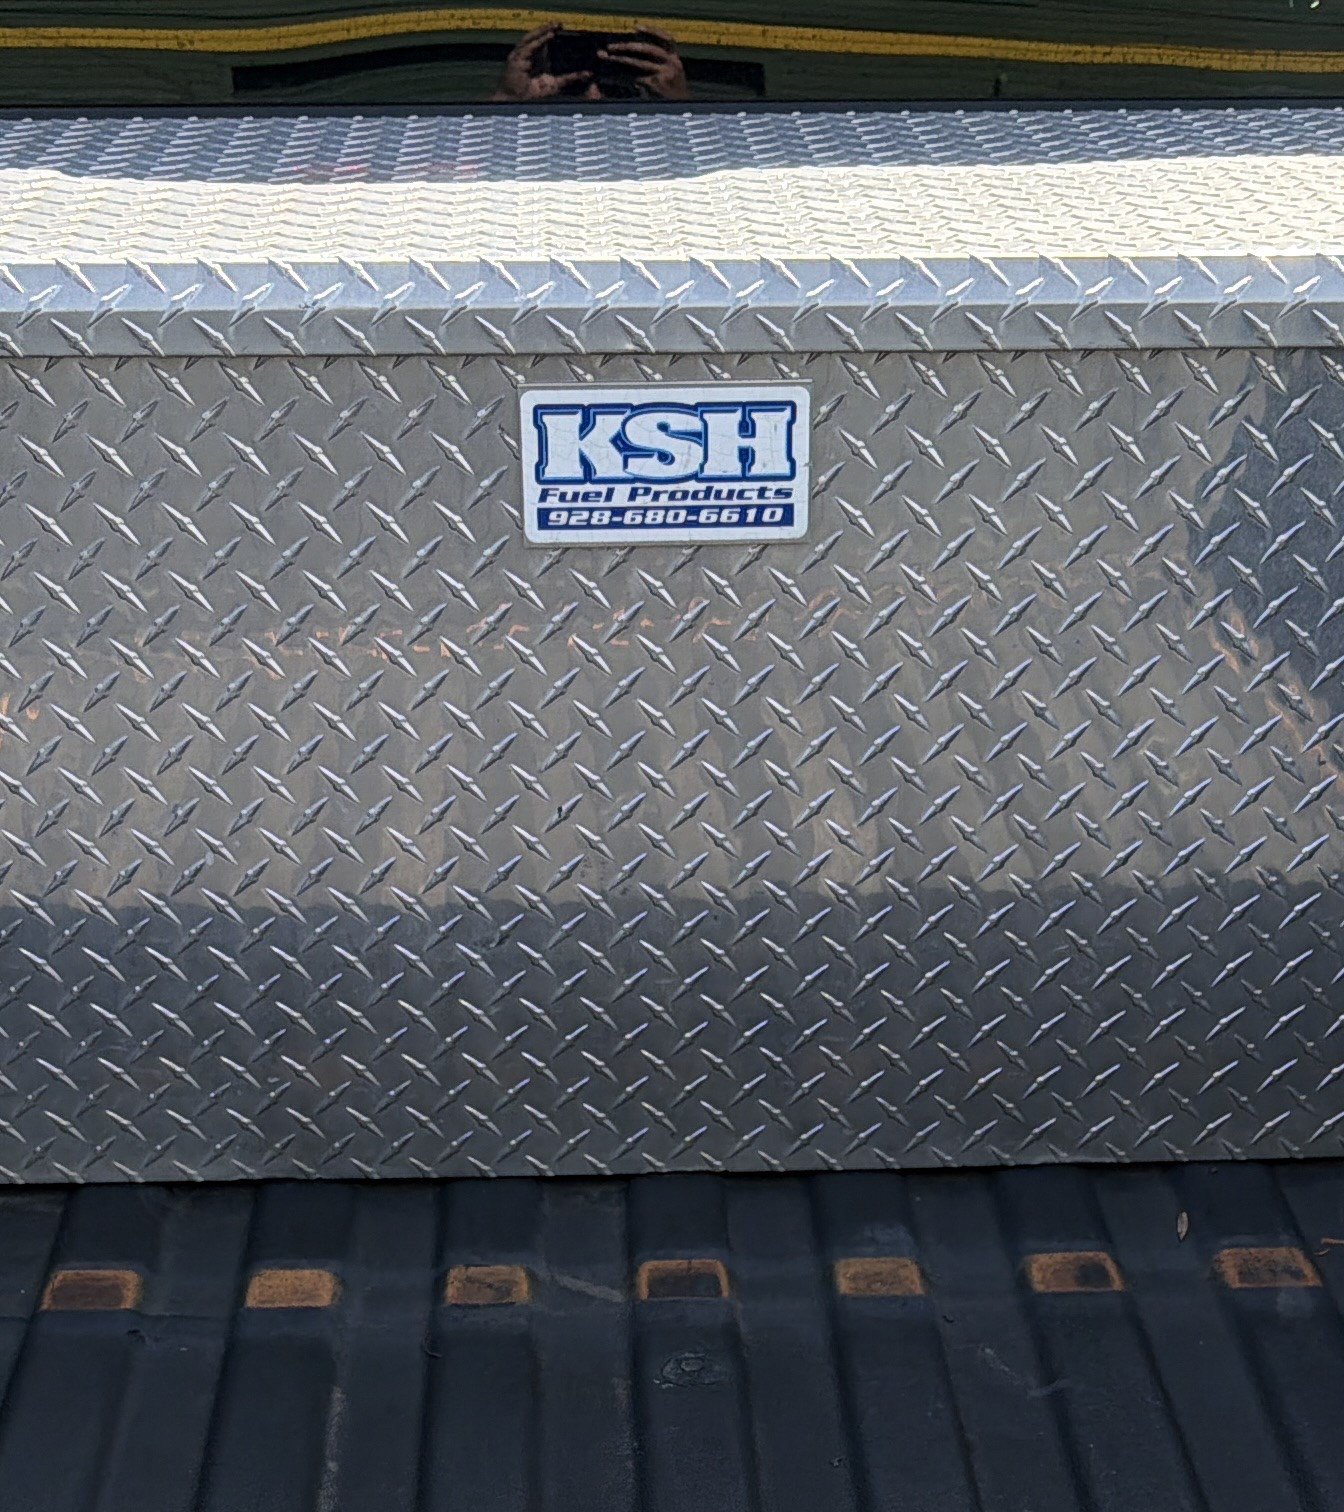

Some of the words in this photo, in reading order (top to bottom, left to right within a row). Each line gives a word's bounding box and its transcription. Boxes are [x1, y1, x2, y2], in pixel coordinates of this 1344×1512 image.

[533, 400, 797, 485] KSH
[538, 486, 615, 503] Fuel
[627, 485, 794, 502] Products
[547, 506, 784, 527] 928-680-6610
